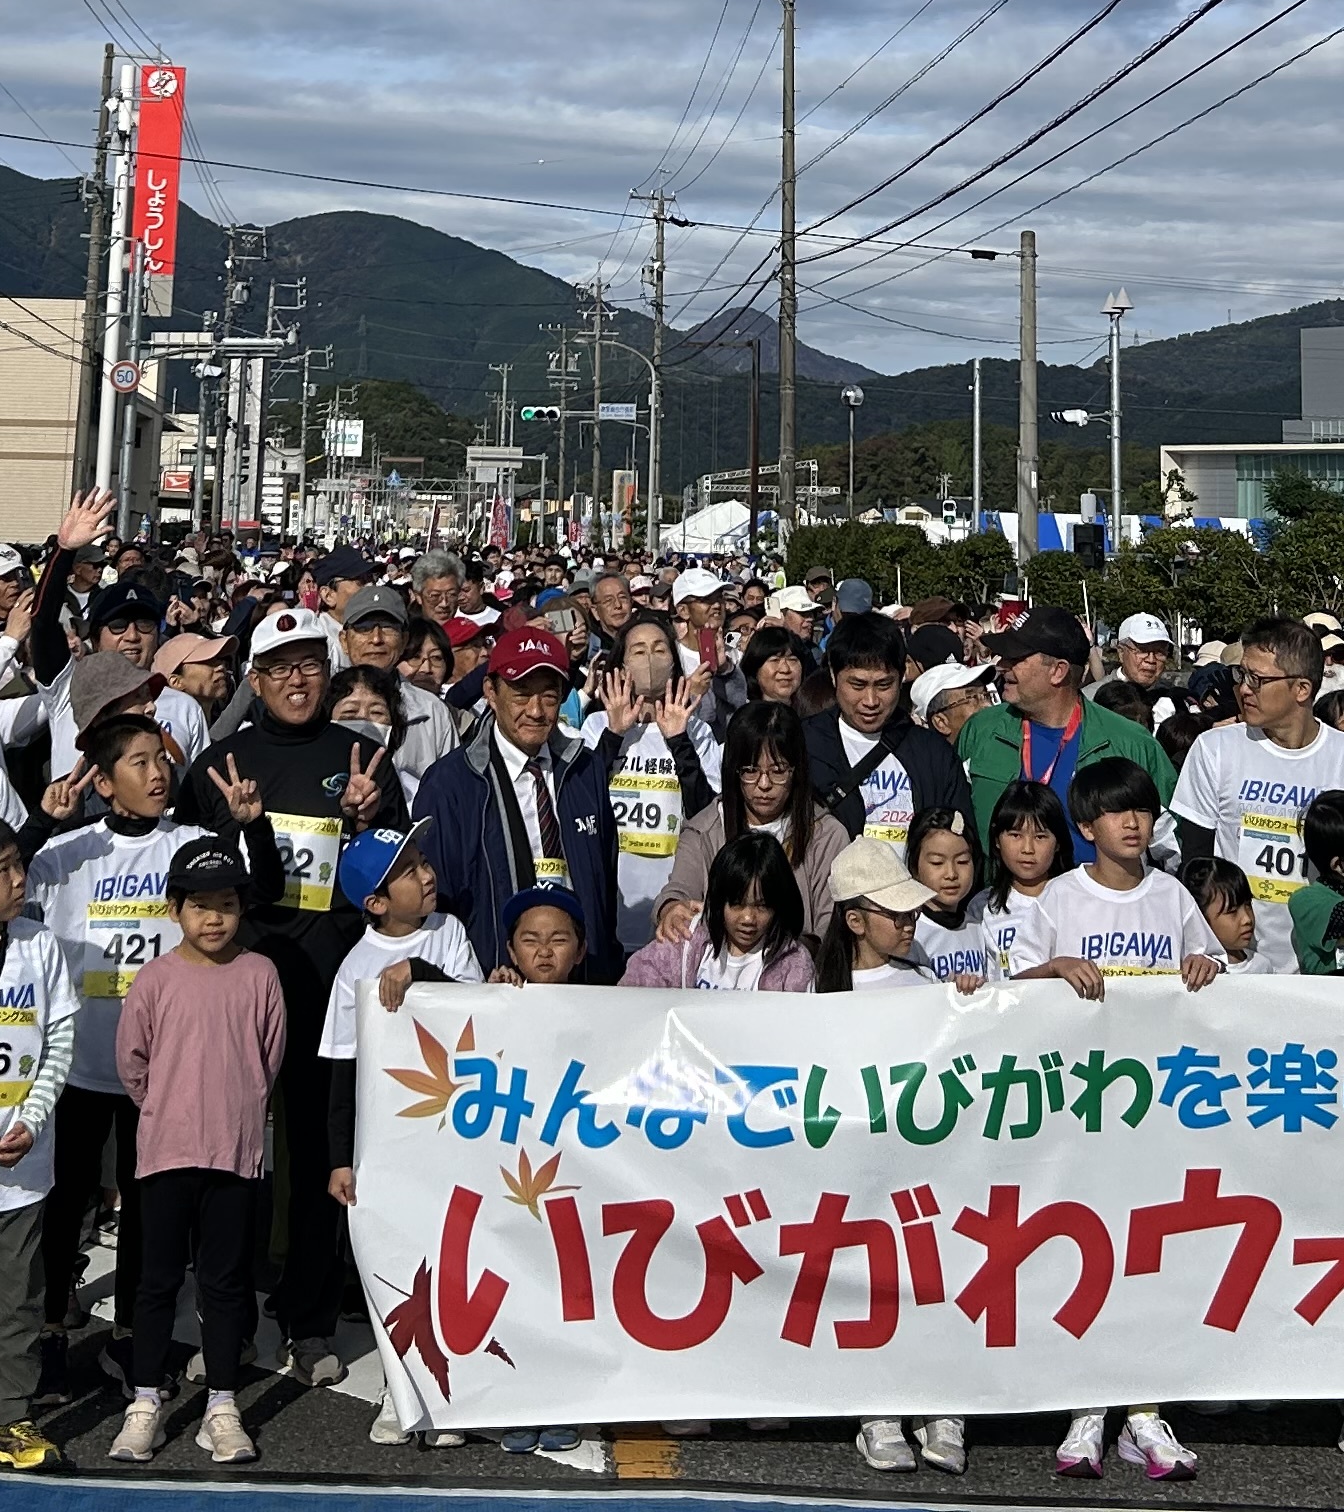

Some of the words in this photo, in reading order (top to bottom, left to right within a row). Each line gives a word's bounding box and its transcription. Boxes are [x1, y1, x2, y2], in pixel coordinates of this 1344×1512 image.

[116, 369, 135, 384] 50
[613, 801, 662, 830] 249
[1255, 844, 1310, 878] 401
[103, 932, 163, 965] 421
